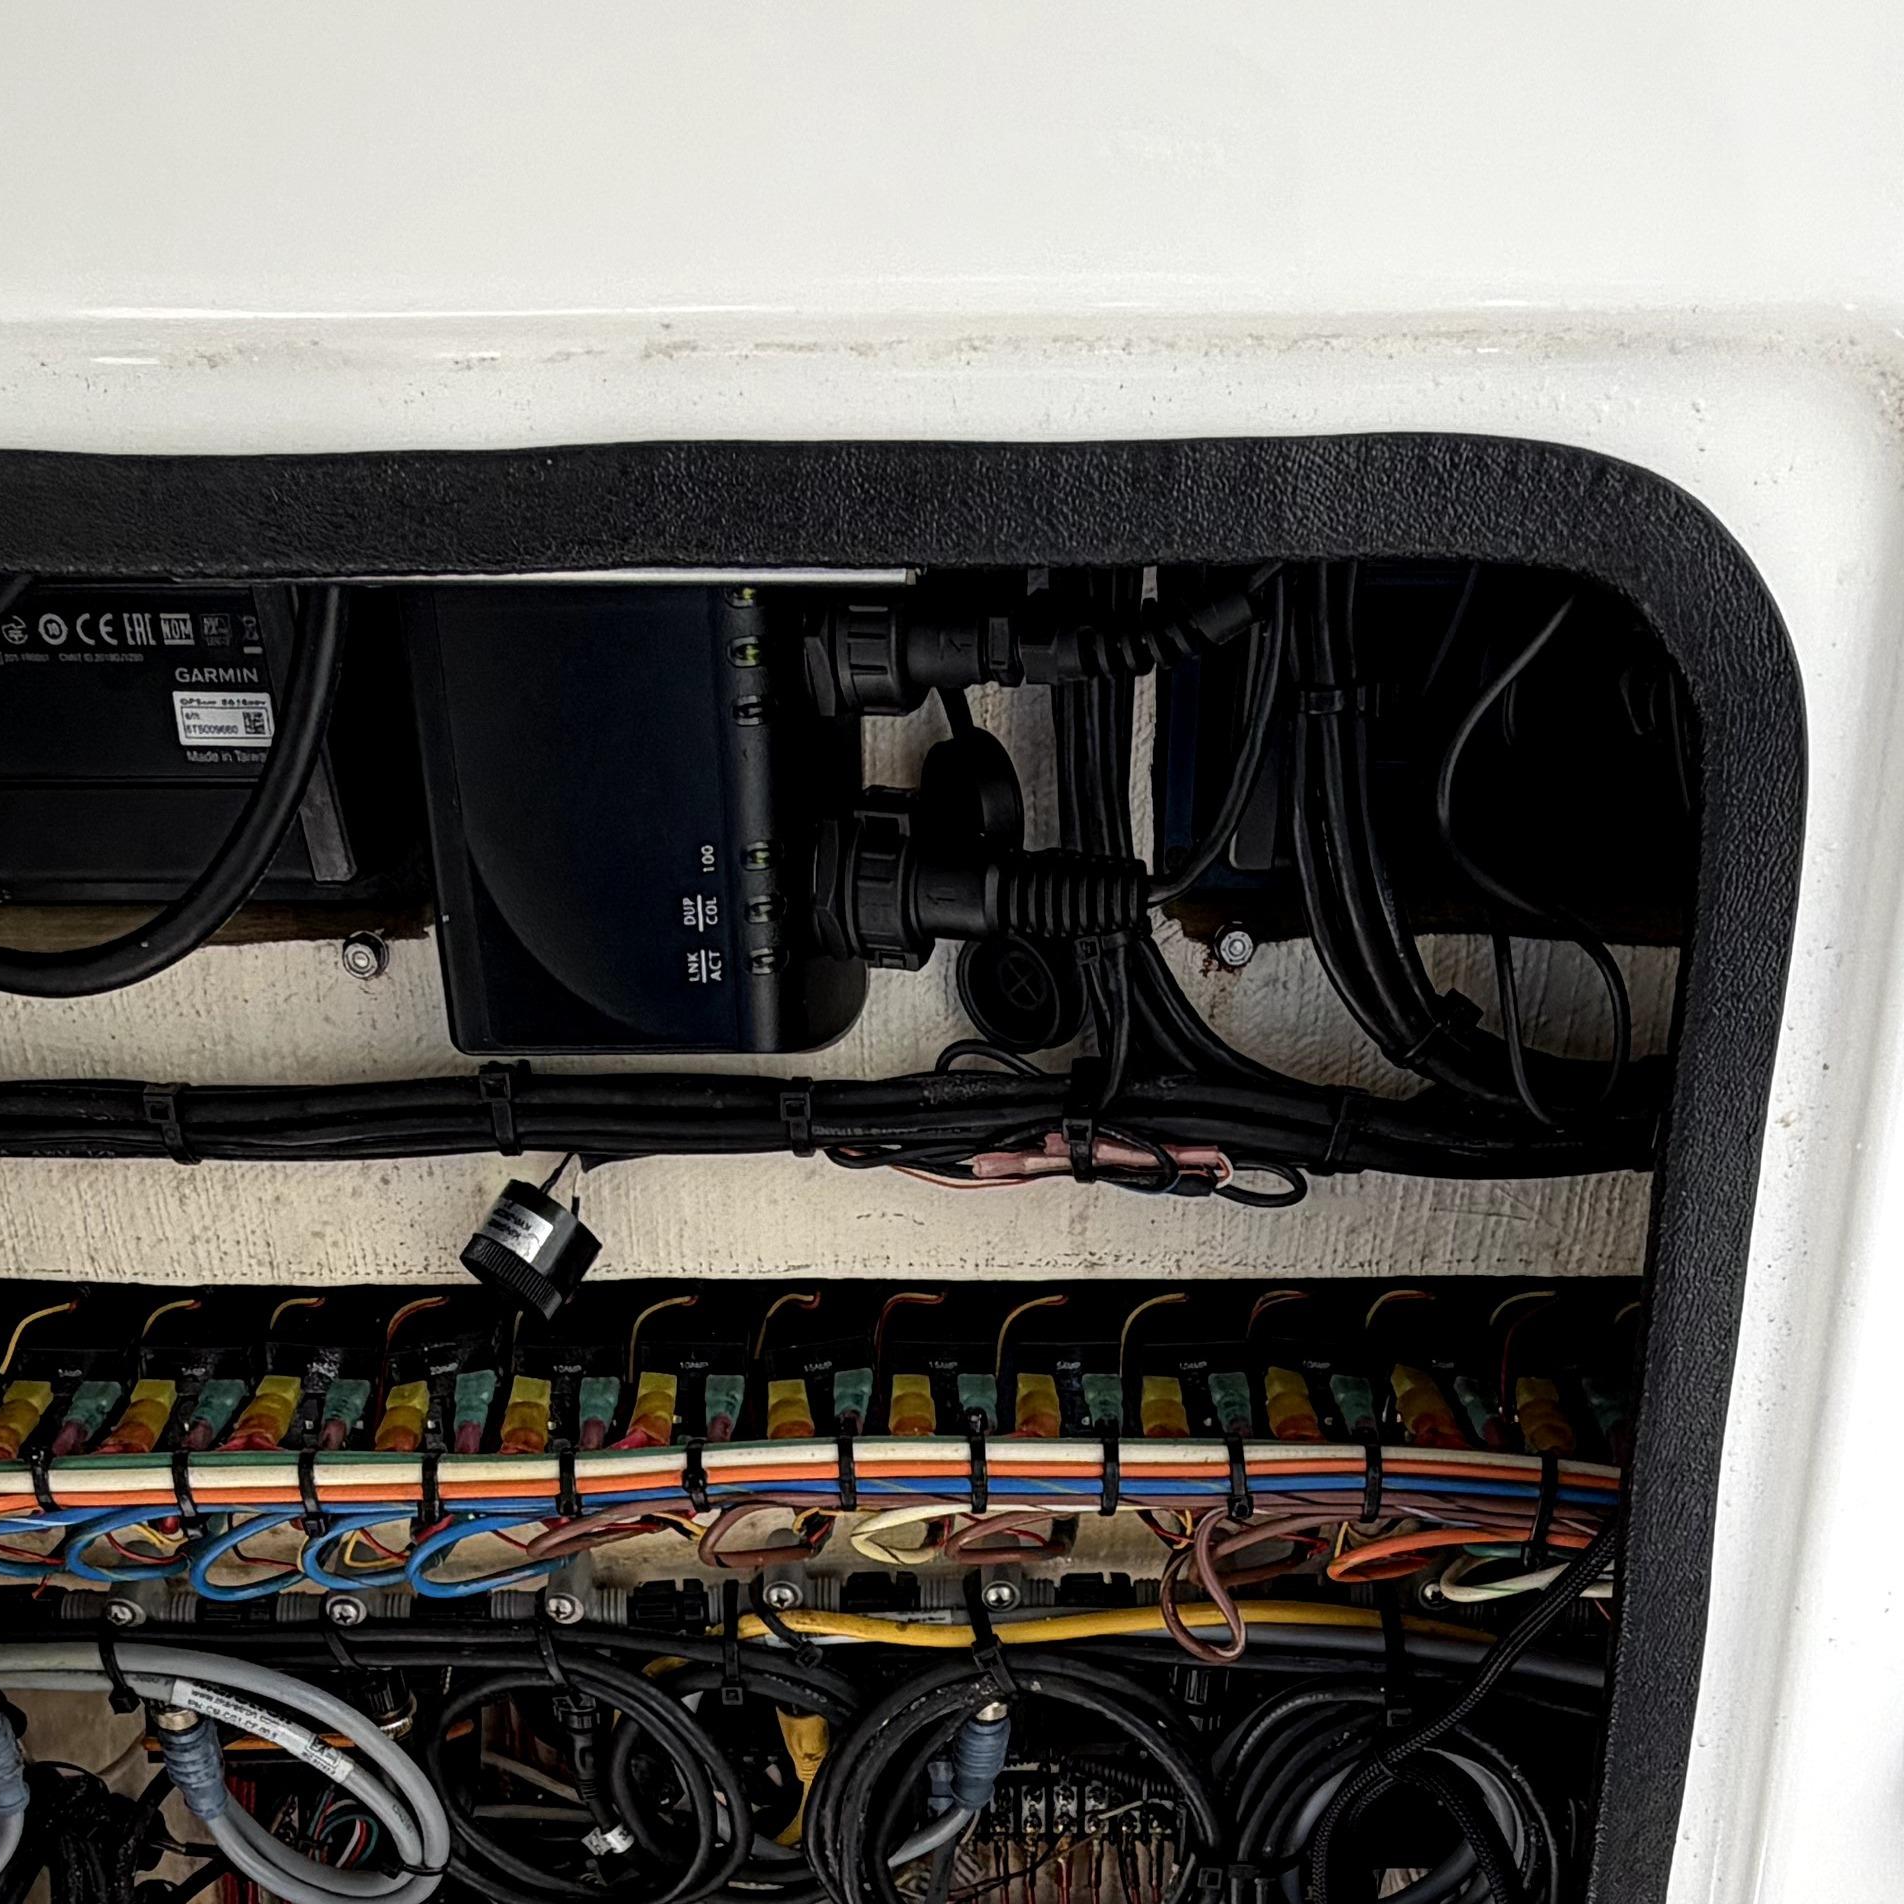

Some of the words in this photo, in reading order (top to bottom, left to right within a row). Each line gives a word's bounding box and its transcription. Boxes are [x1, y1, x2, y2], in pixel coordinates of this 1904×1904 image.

[160, 622, 194, 641] NOM
[175, 667, 260, 683] GARMIN
[186, 750, 221, 763] Made
[700, 844, 716, 873] 100
[682, 897, 697, 927] DUP
[704, 896, 719, 926] COL
[686, 952, 701, 983] LNK
[708, 949, 723, 982] ACT
